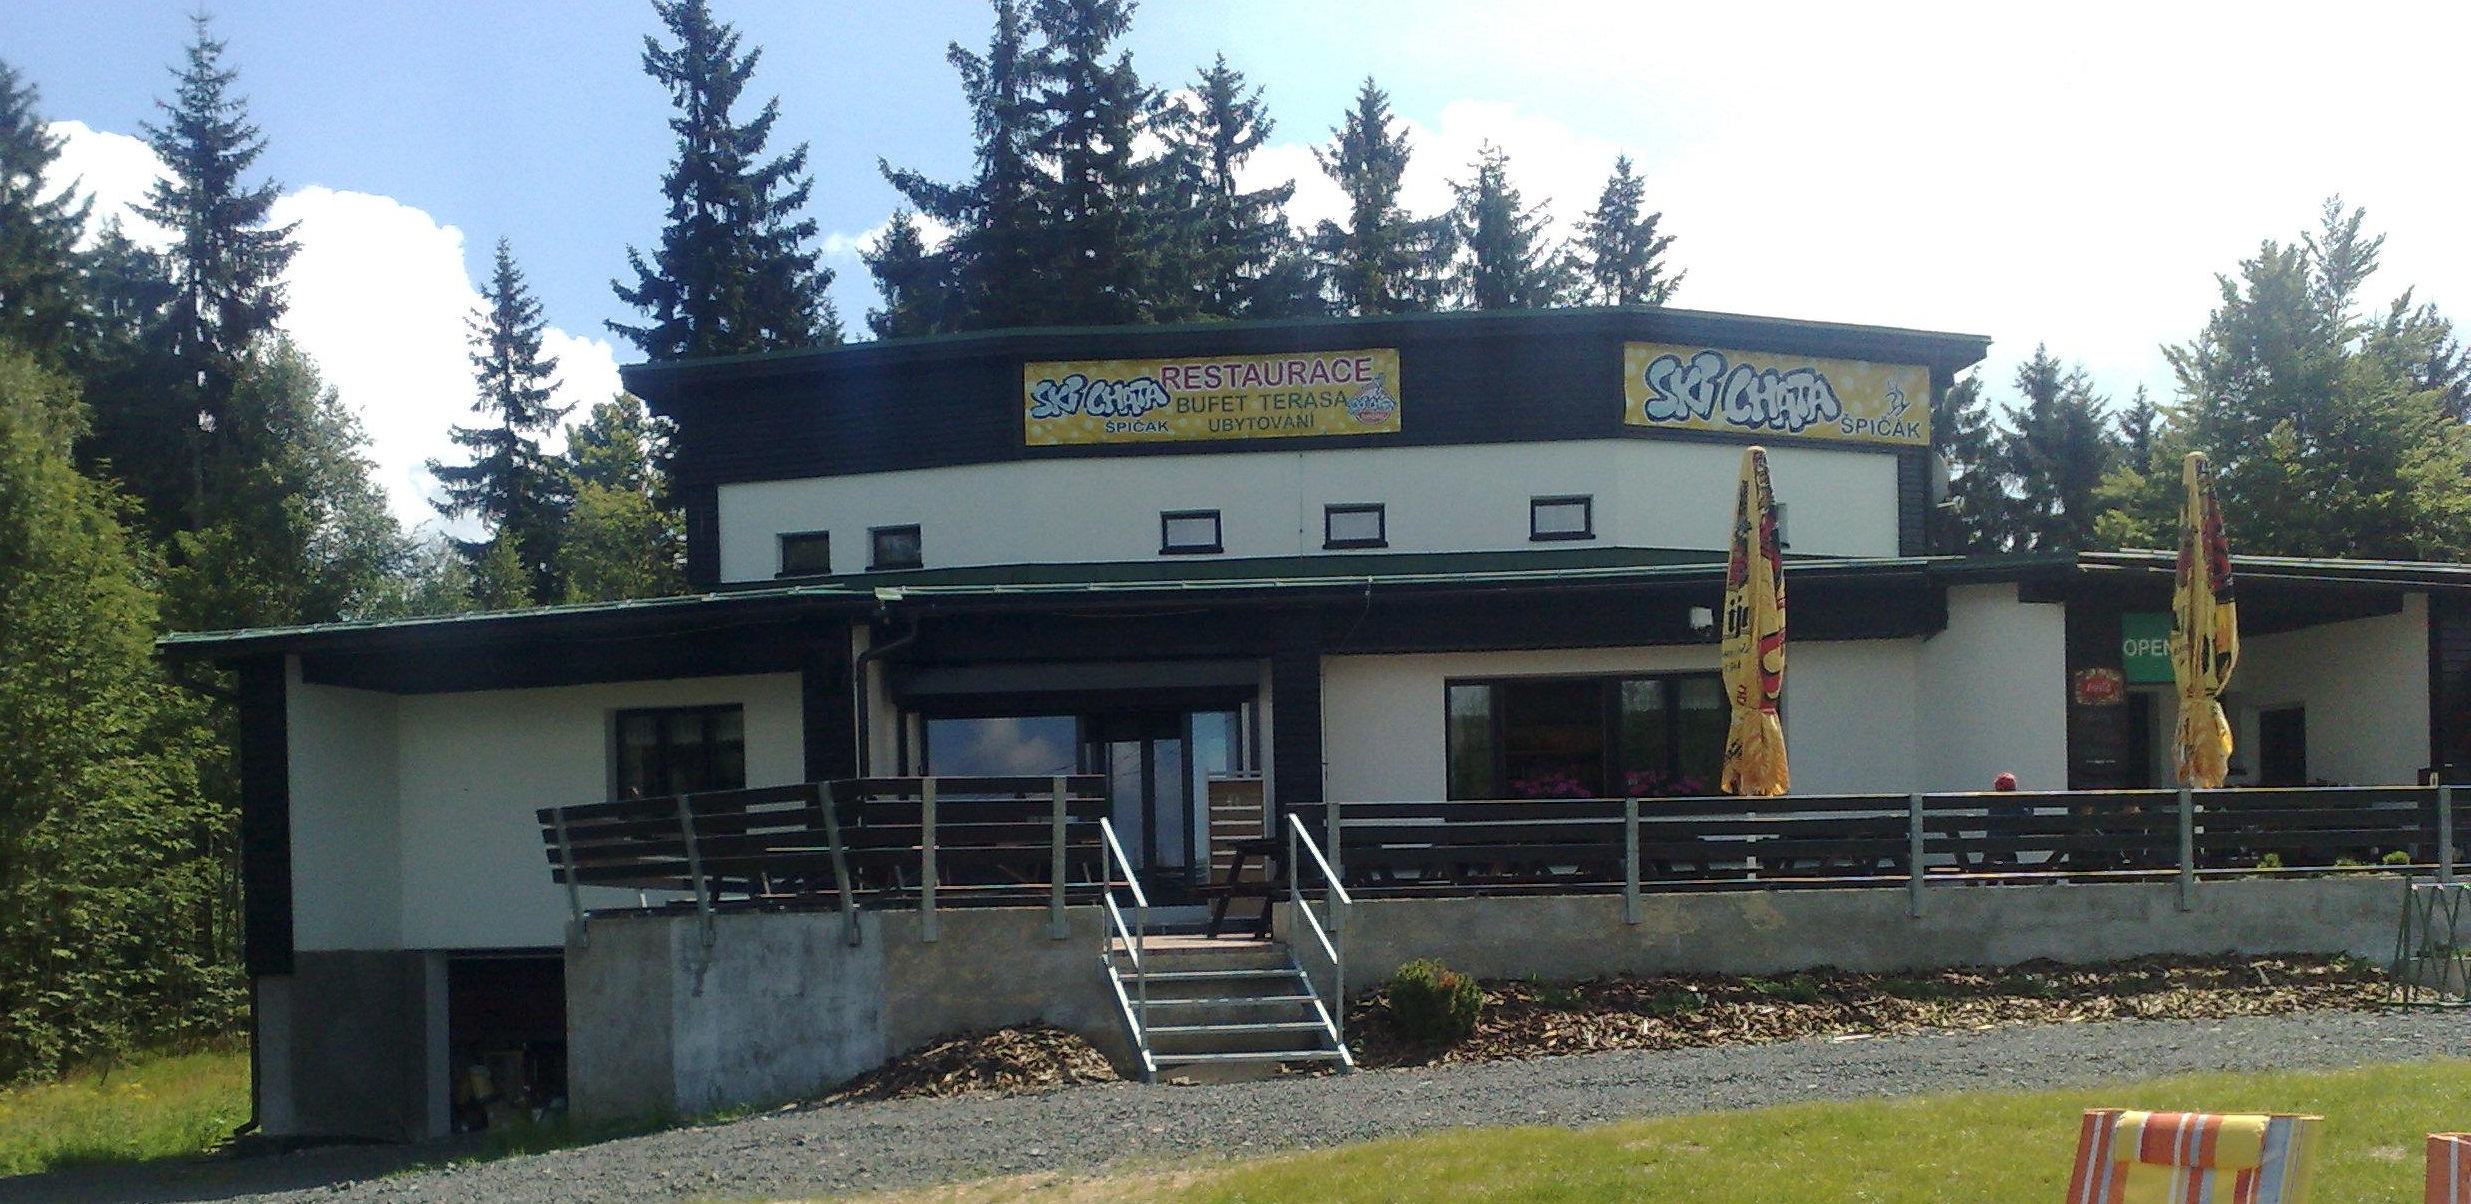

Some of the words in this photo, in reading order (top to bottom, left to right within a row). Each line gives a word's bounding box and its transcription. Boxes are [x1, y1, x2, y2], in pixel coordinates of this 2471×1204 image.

[1160, 357, 1373, 390] RESTAURACE
[1085, 377, 1170, 417] CHATA
[1177, 395, 1247, 413] BUFET
[1259, 391, 1346, 411] TERASA
[1645, 349, 1729, 422] SKI
[1722, 363, 1842, 433] CHATA
[1105, 420, 1169, 433] ŠPIČAK
[1841, 413, 1920, 438] ŠPIČAK
